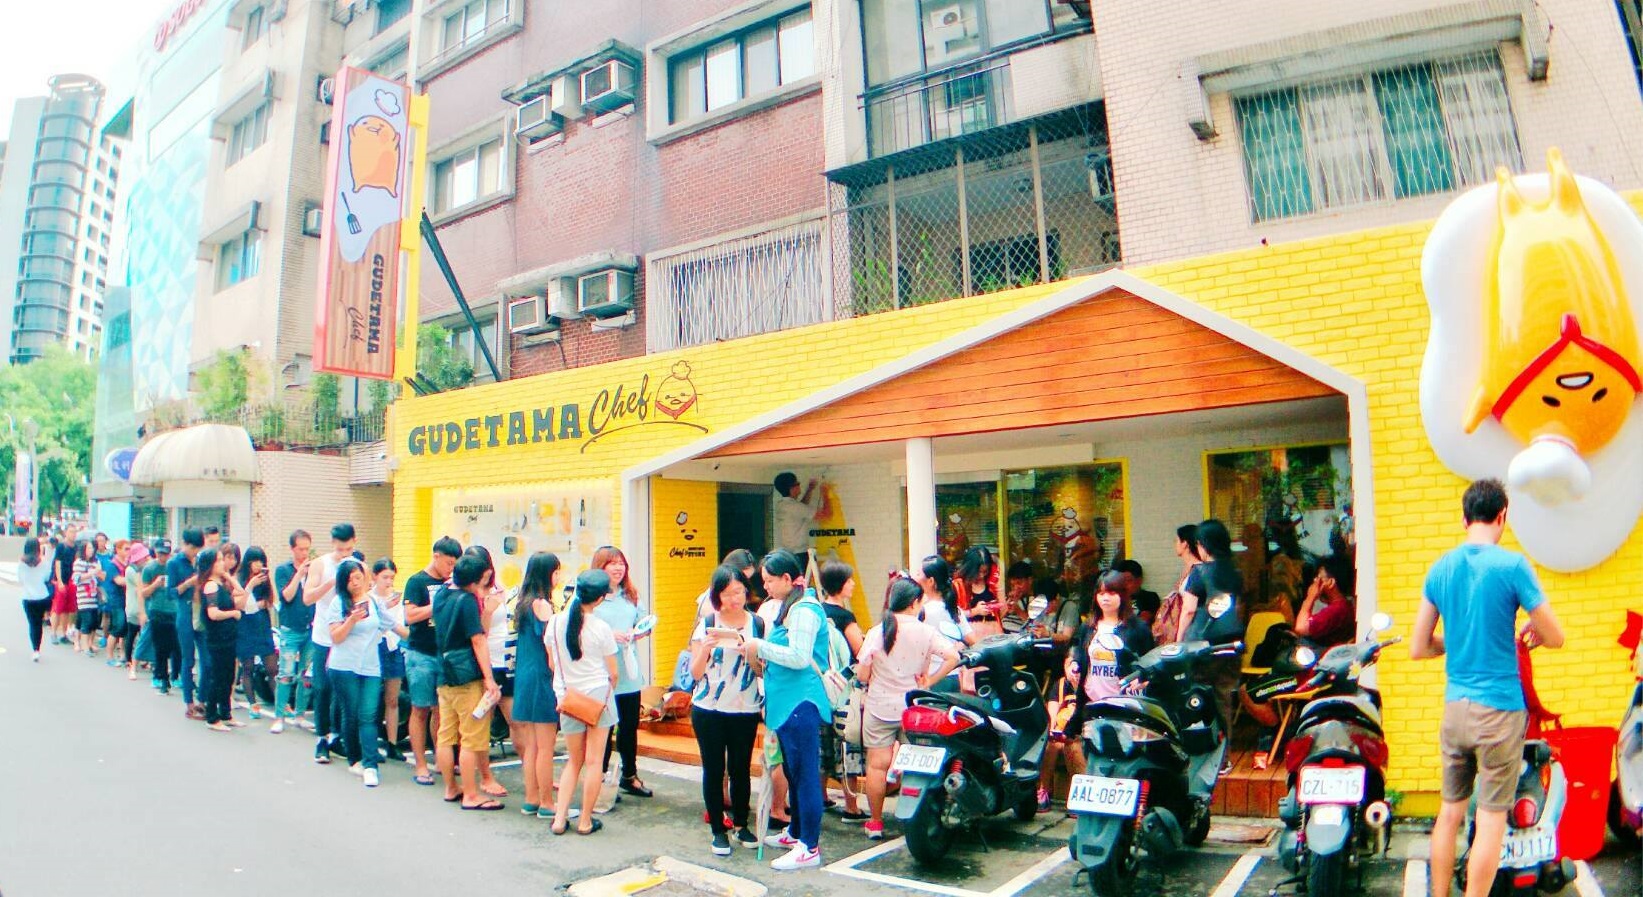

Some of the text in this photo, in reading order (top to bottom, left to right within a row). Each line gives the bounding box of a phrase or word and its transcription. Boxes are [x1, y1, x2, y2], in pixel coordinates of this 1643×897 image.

[367, 253, 384, 354] GUDETAMA
[408, 373, 653, 456] GUDETAMA Chef
[808, 528, 856, 537] GUDETAMA
[1071, 785, 1134, 806] AAL-0877
